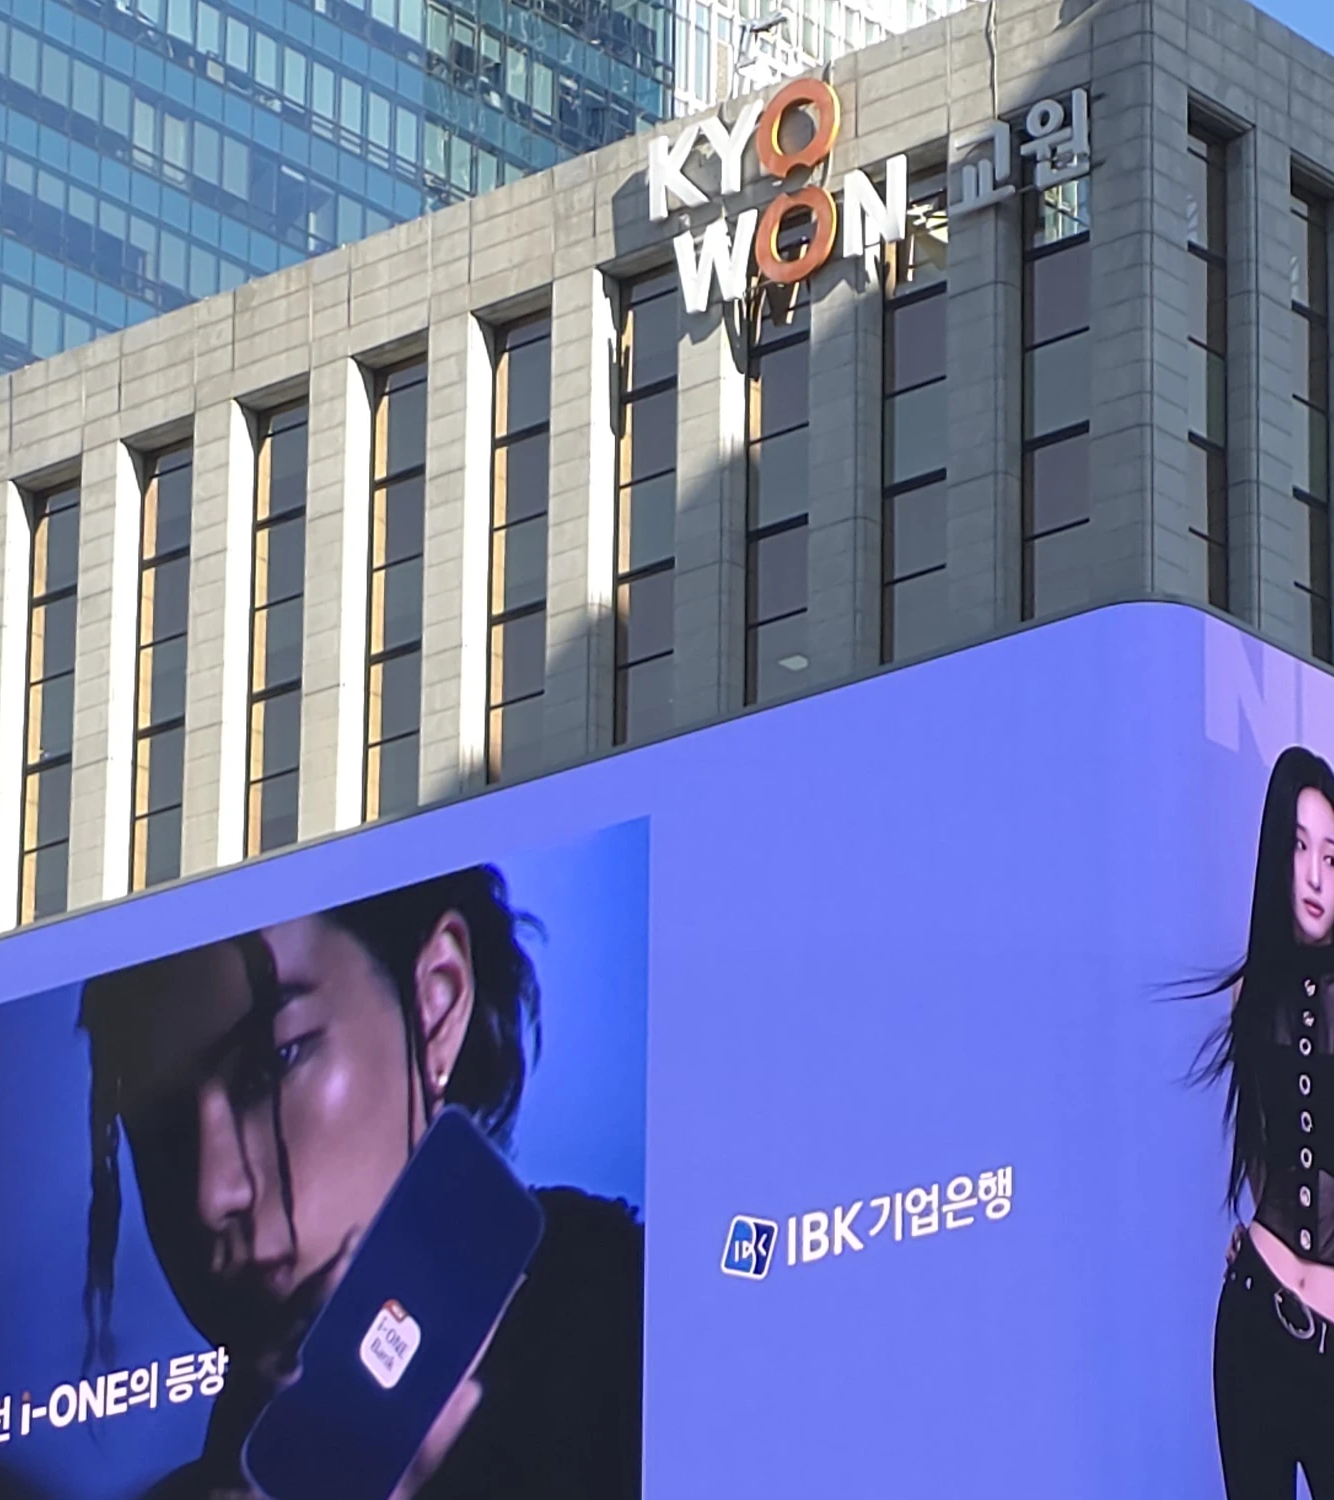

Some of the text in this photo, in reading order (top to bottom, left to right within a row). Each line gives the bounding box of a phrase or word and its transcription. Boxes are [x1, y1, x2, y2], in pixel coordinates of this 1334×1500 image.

[948, 86, 1091, 217] 교원
[20, 1362, 158, 1436] i-ONE의
[166, 1346, 229, 1404] 등장
